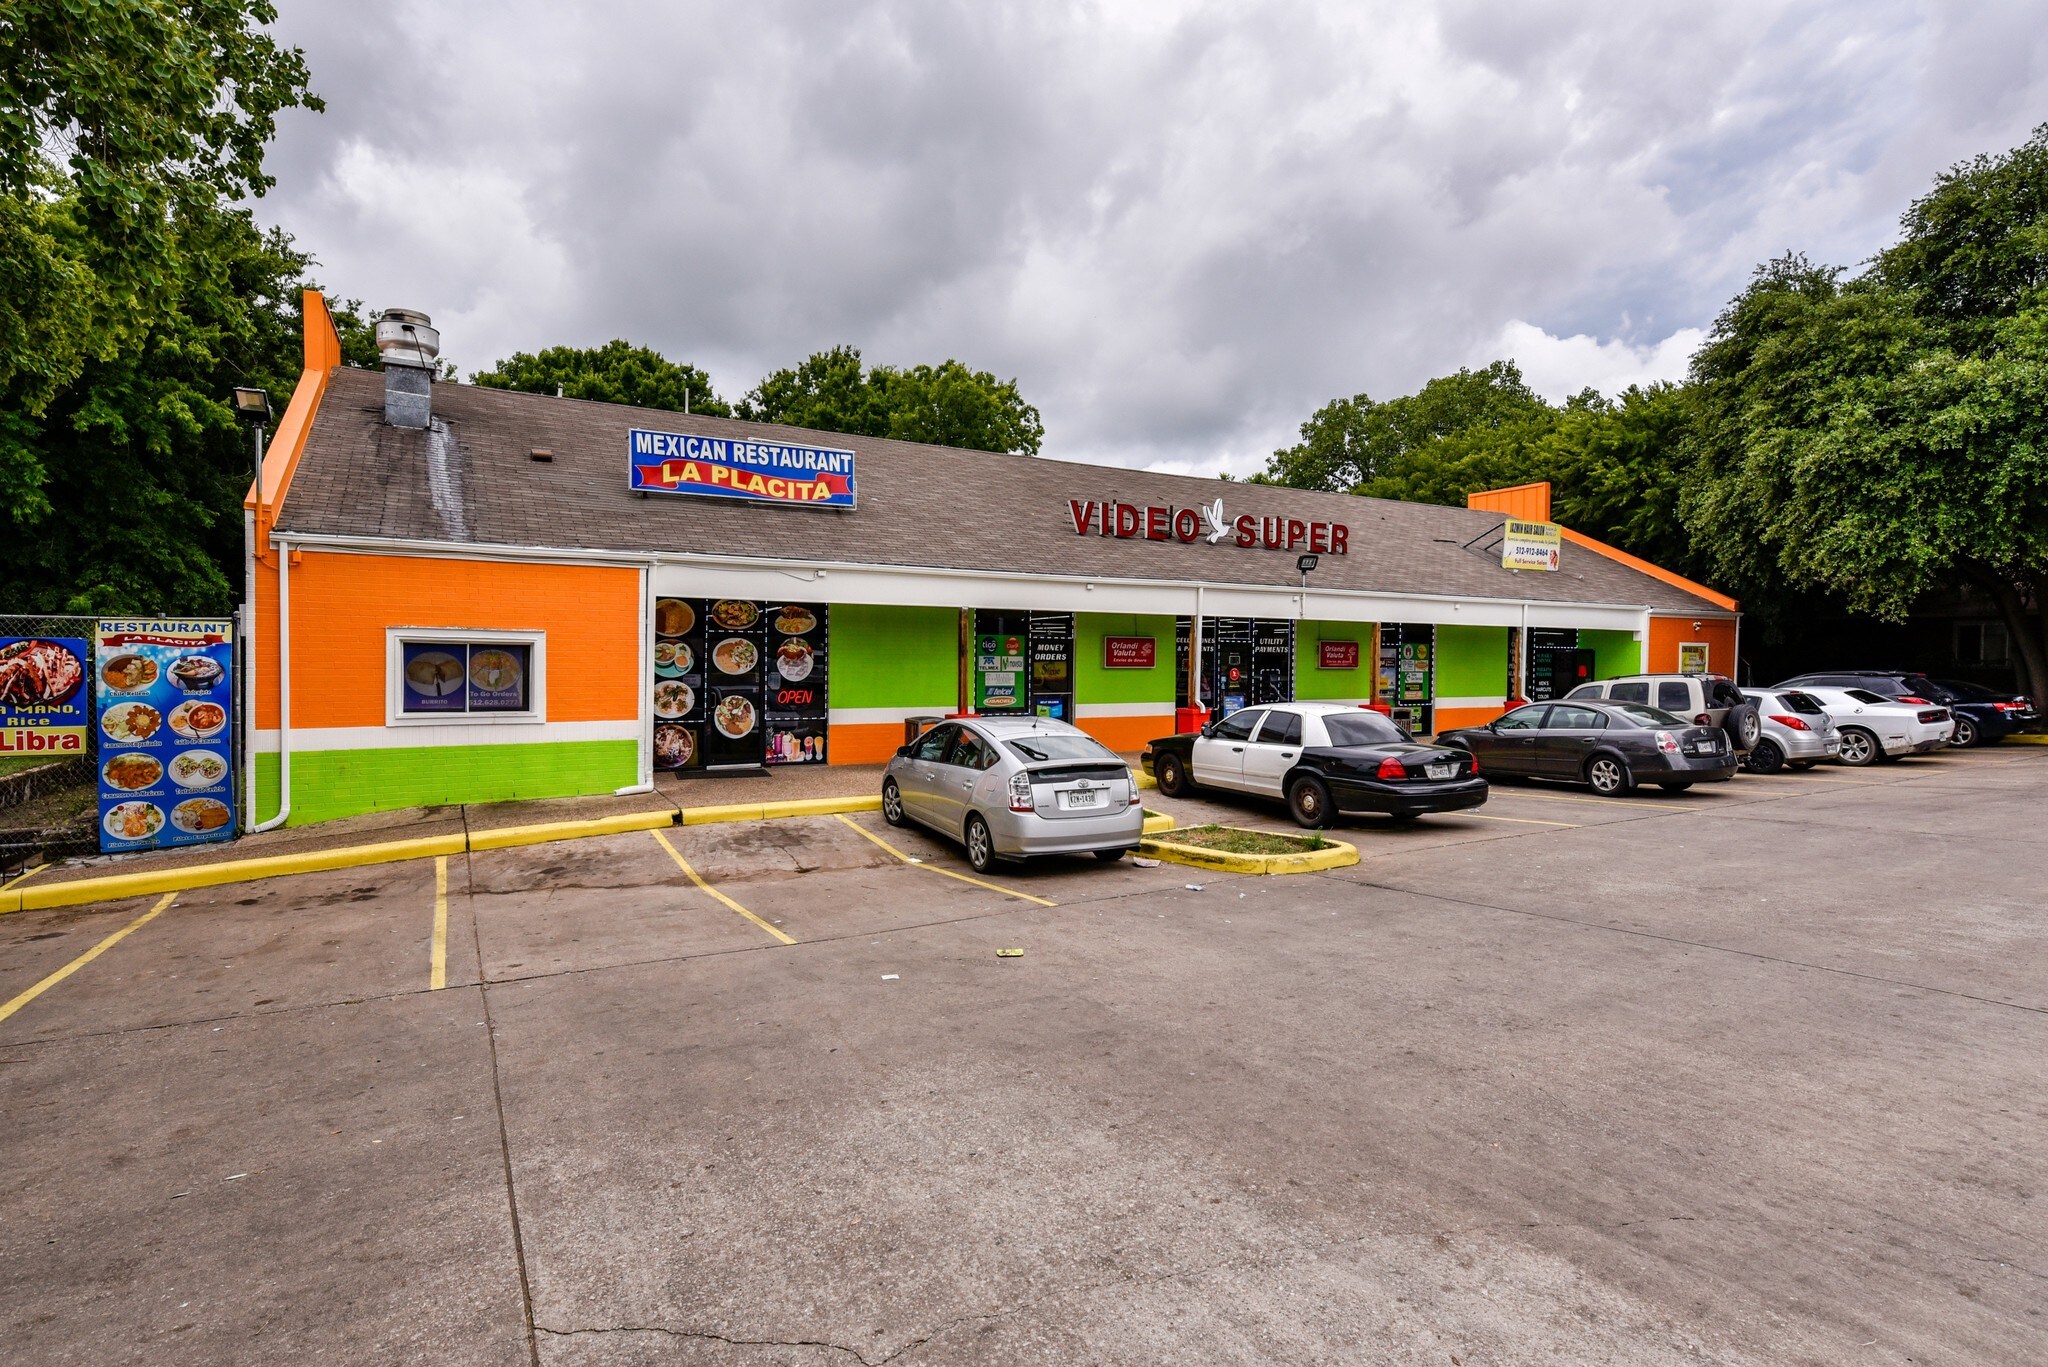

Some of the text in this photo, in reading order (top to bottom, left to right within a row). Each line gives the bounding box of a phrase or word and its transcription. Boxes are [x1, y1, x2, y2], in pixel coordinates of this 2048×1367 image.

[636, 432, 851, 473] MEXICAN RESTAURANT
[662, 462, 831, 500] LA PLACITA
[1068, 499, 1349, 554] VIDEO SUPER
[1523, 524, 1533, 535] HAIR
[1533, 525, 1545, 536] SALON
[100, 622, 228, 633] RESTAURANT
[147, 636, 207, 646] PLACITA
[777, 690, 813, 704] OPEN
[993, 687, 1013, 695] telcel
[15, 704, 80, 715] MANO,
[7, 717, 50, 726] Rice
[0, 730, 80, 751] Libra
